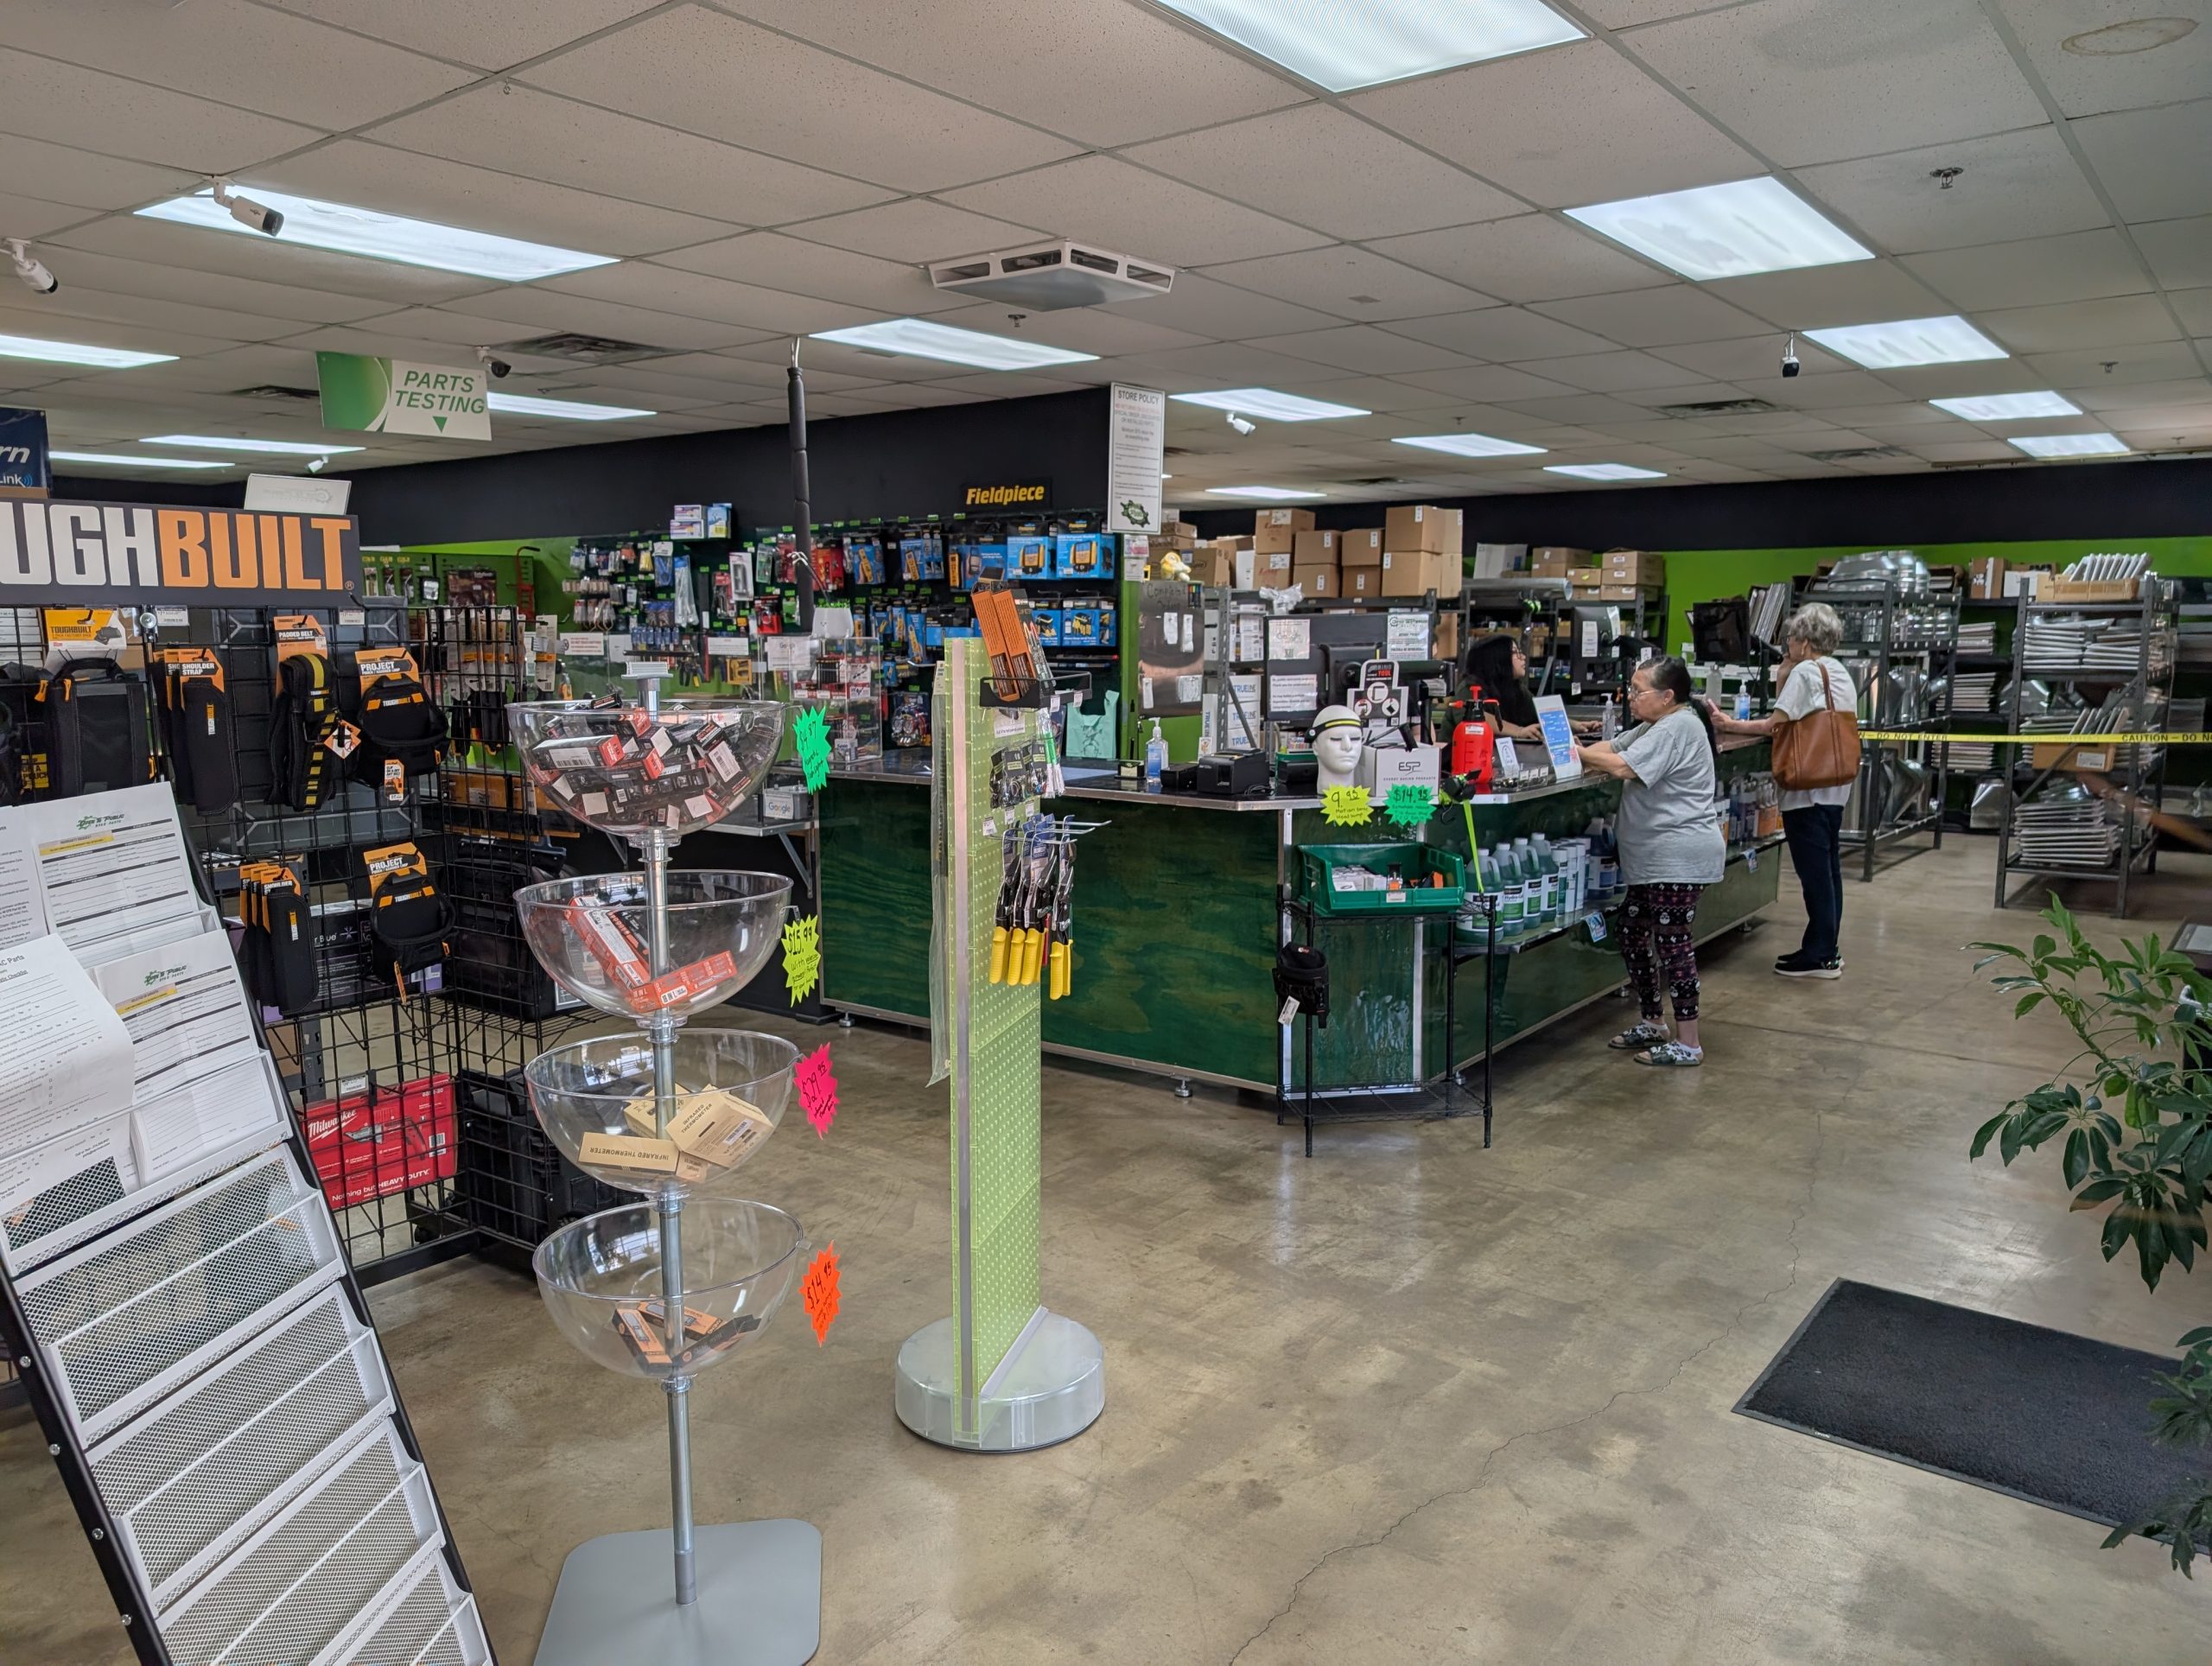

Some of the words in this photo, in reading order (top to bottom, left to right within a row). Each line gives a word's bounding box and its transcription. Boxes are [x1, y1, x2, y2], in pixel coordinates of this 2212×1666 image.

[404, 370, 474, 392] PARTS
[396, 390, 485, 414] TESTING
[1118, 390, 1138, 401] STORE
[1139, 393, 1159, 404] POLICY
[966, 485, 1045, 506] Fieldpiece
[50, 626, 92, 634] TOUGHBUILT
[360, 661, 395, 671] PROJECT
[1398, 761, 1421, 772] ESP
[768, 801, 791, 813] Google
[370, 857, 403, 872] PROJECT
[6, 954, 25, 963] Parts
[7, 970, 29, 979] Checklist
[680, 1103, 713, 1134] THERMOMETER
[683, 1103, 705, 1125] INFRARED
[589, 1147, 636, 1158] THERMOMETER
[637, 1151, 670, 1161] INFRARED
[363, 1182, 376, 1192] but
[378, 1175, 405, 1188] HEAVY
